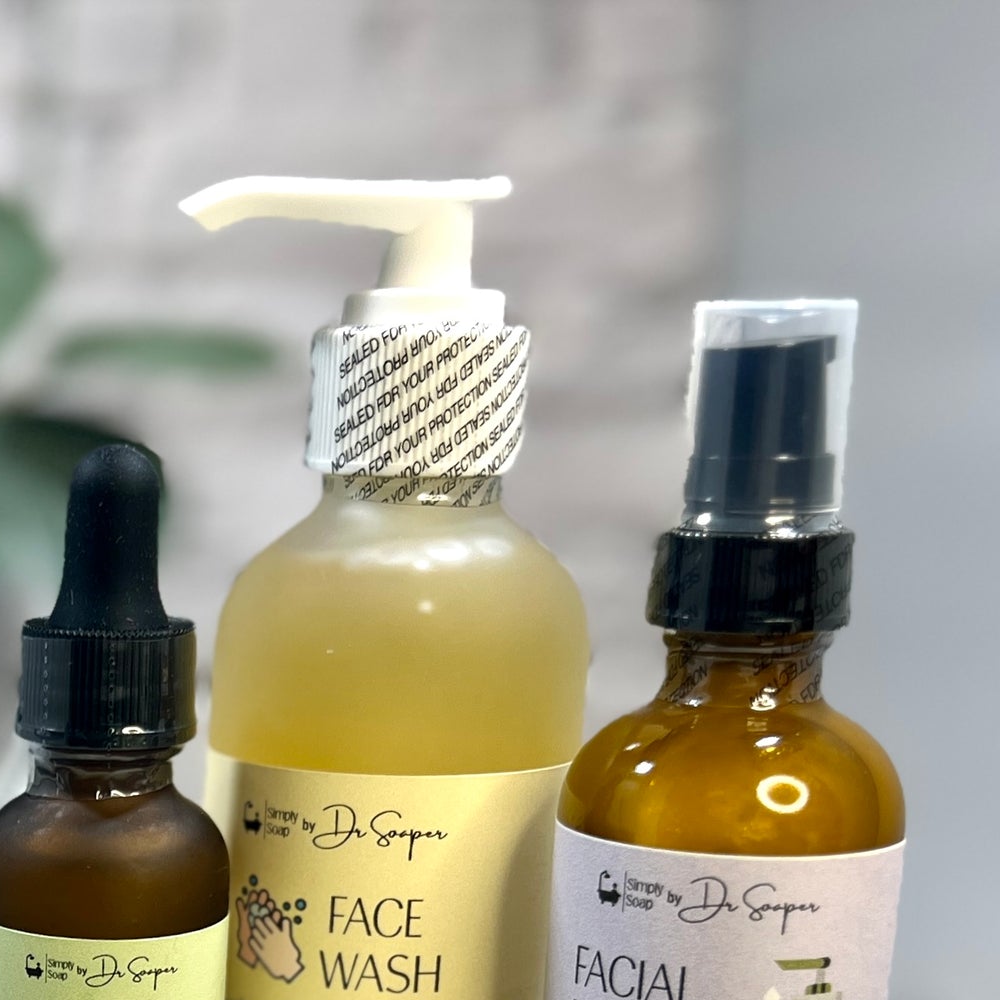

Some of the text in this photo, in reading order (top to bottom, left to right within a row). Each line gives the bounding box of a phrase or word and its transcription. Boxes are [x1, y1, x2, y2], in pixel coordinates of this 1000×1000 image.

[339, 337, 380, 379] SEALED
[460, 340, 495, 381] SEALED
[337, 347, 409, 411] PROTECTION
[334, 403, 375, 444] SEALED
[401, 360, 435, 394] YOUR
[394, 426, 428, 458] YOUR
[428, 373, 492, 436] PROTECTION
[401, 392, 434, 424] YOUR
[331, 414, 400, 475] PROTECTION
[454, 405, 490, 446] SEALED
[266, 823, 290, 838] Soap
[267, 807, 300, 825] Simply
[302, 803, 449, 861] by Dr Soaper
[625, 895, 654, 911] Soap
[626, 877, 664, 897] Simply
[667, 876, 820, 936] by Dr Soaper
[328, 895, 425, 938] FACE
[47, 958, 75, 971] Simply
[47, 970, 68, 982] Soap
[76, 965, 88, 976] by
[85, 954, 126, 988] Dr
[318, 949, 443, 994] WASH
